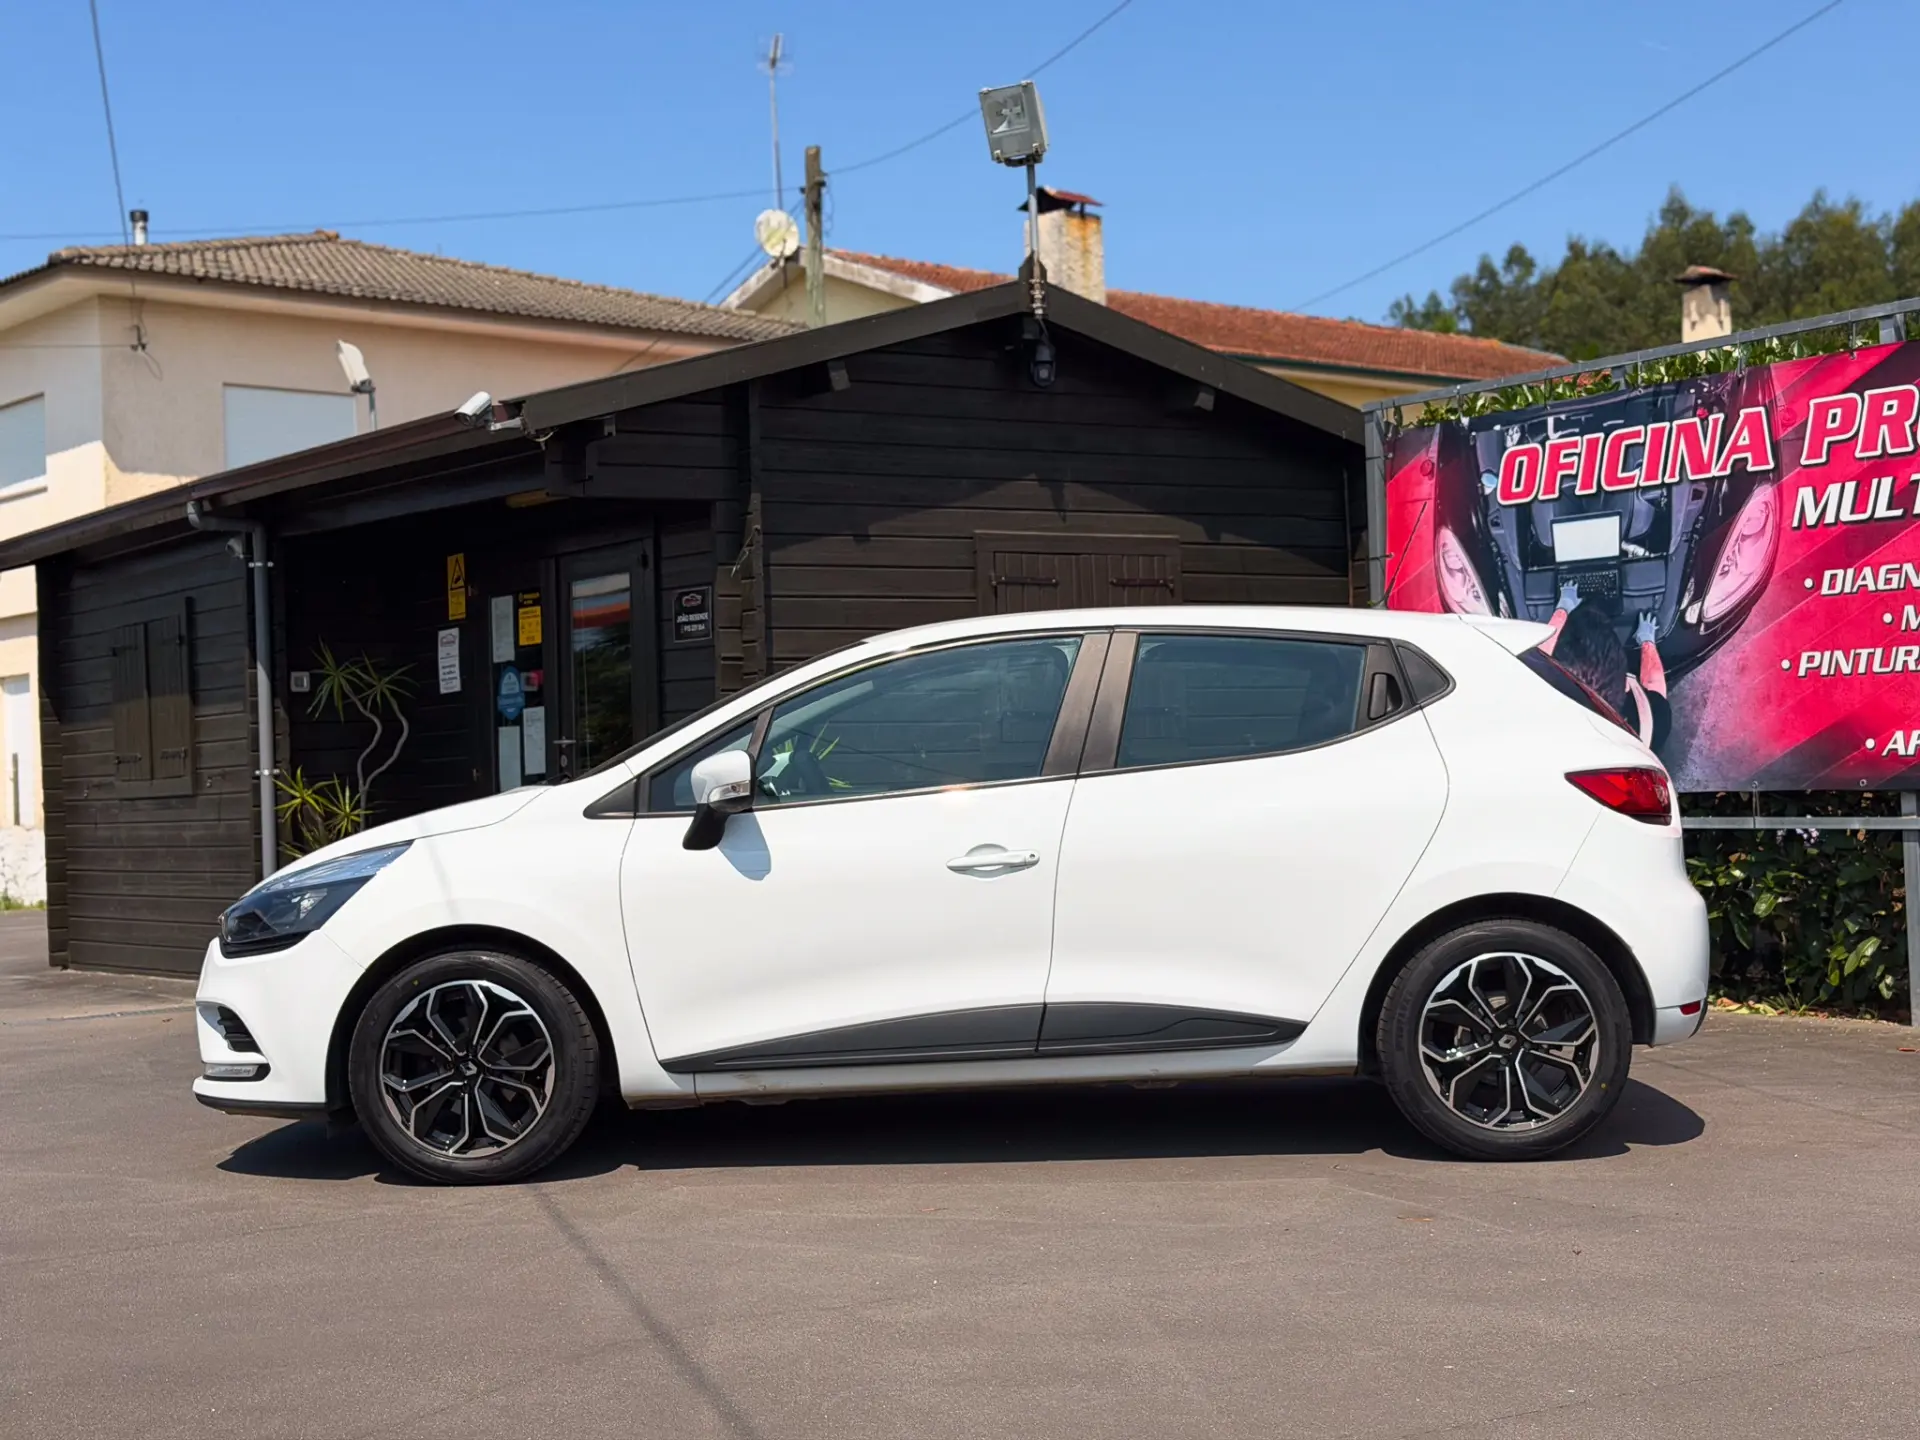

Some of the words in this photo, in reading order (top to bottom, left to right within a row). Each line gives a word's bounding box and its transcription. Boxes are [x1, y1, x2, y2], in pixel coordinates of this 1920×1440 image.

[1497, 406, 1775, 506] OFICINA
[1800, 384, 1920, 466] PR
[1797, 645, 1920, 678] PINTUR
